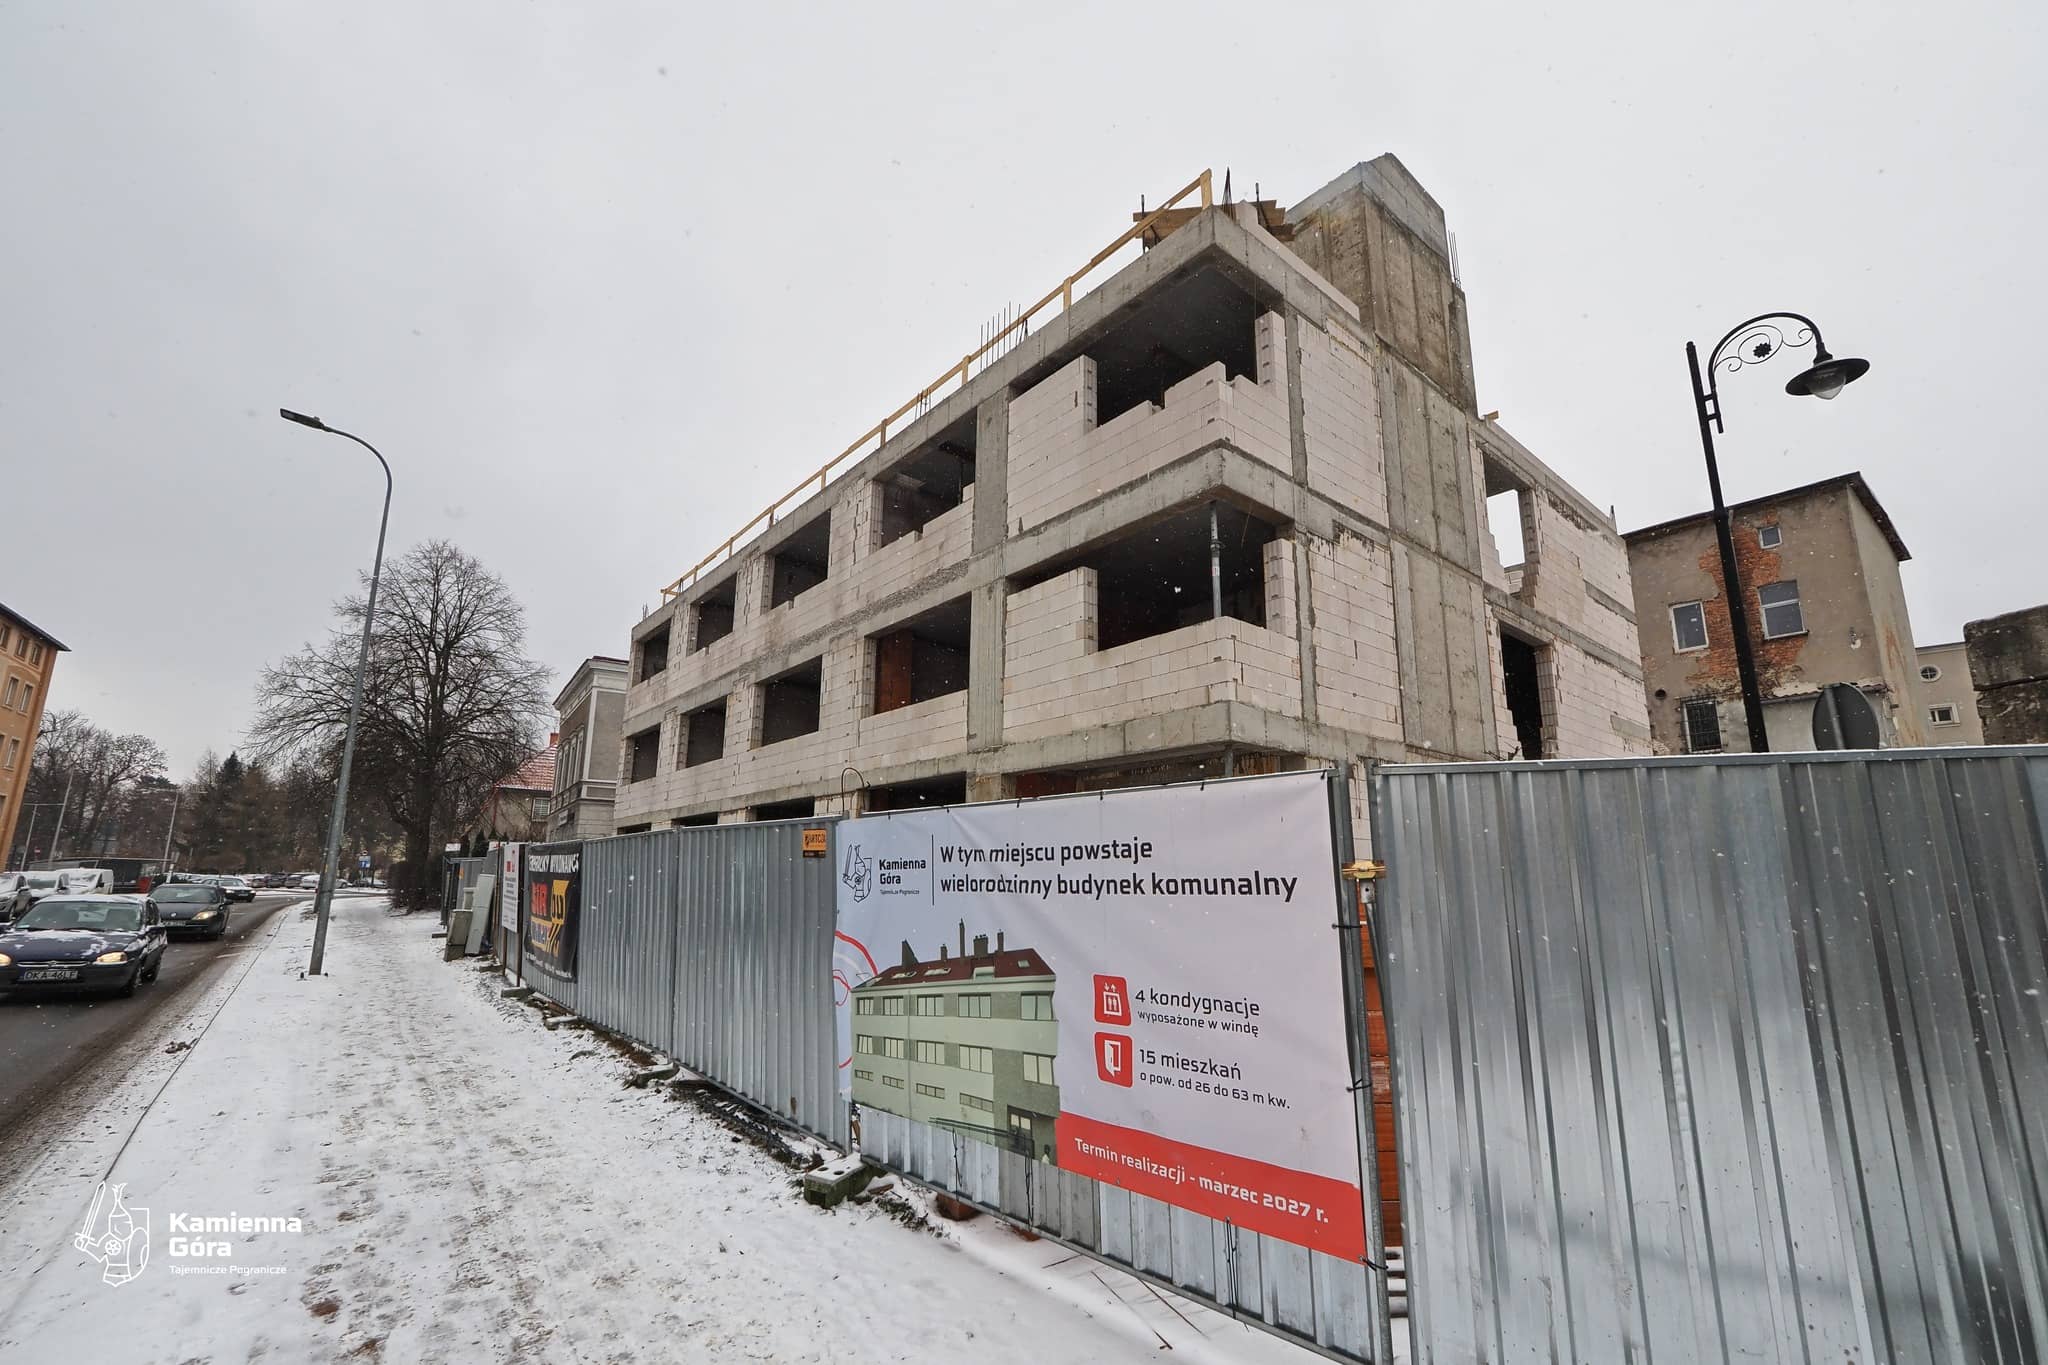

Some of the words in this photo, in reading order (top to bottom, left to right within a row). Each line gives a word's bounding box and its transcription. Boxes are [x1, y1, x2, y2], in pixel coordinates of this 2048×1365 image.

[879, 857, 926, 870] Kamienna
[940, 846, 954, 862] W
[958, 846, 986, 867] tym
[989, 842, 1055, 866] miejscu
[1060, 836, 1153, 866] powstaje
[879, 871, 902, 885] Góra
[940, 873, 1052, 899] wielorodzinny
[1057, 872, 1146, 900] budynek
[1151, 870, 1298, 903] komunalny
[1135, 989, 1145, 1003] 4
[1150, 987, 1260, 1019] kondygnacje
[1137, 1010, 1205, 1029] wyposażone
[1207, 1020, 1218, 1029] w
[1221, 1019, 1259, 1037] windę
[1139, 1049, 1156, 1065] 15
[1161, 1052, 1241, 1080] mieszkań
[1140, 1072, 1147, 1081] o
[1149, 1073, 1175, 1086] pow.
[1178, 1078, 1192, 1090] od
[1195, 1081, 1211, 1094] 26
[1213, 1084, 1229, 1097] do
[1232, 1088, 1249, 1101] 63
[1252, 1093, 1264, 1104] m
[1268, 1093, 1290, 1109] kw.
[1074, 1137, 1118, 1163] Termin
[1121, 1154, 1186, 1185] realizacji
[1199, 1175, 1258, 1204] marzec
[1263, 1192, 1311, 1217] 2027
[1315, 1207, 1329, 1223] r.
